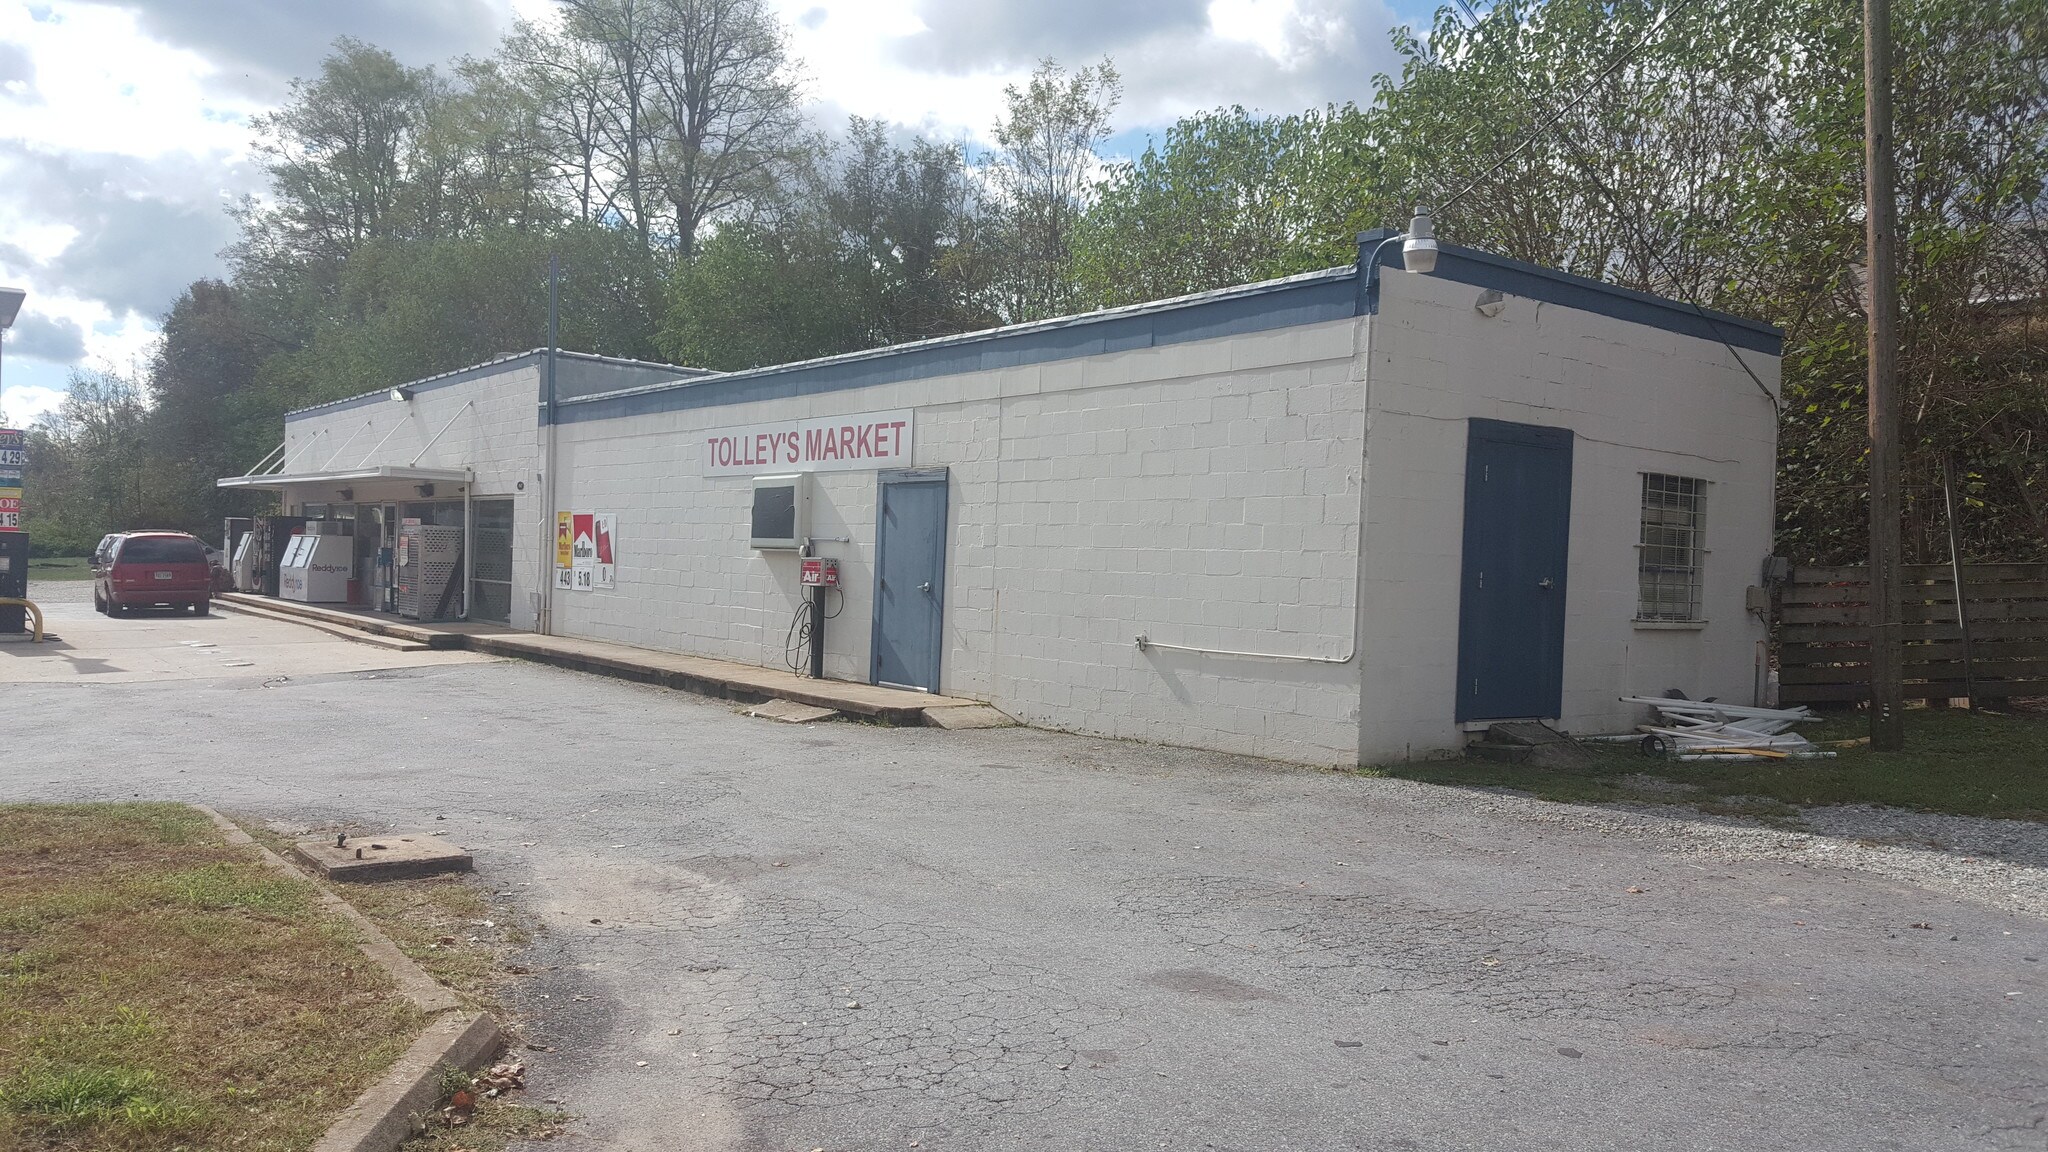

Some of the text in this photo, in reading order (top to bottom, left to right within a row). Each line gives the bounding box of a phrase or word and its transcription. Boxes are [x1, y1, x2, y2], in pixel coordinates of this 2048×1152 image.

[707, 421, 906, 467] TOLLEY'S MARKET
[803, 570, 820, 582] Air
